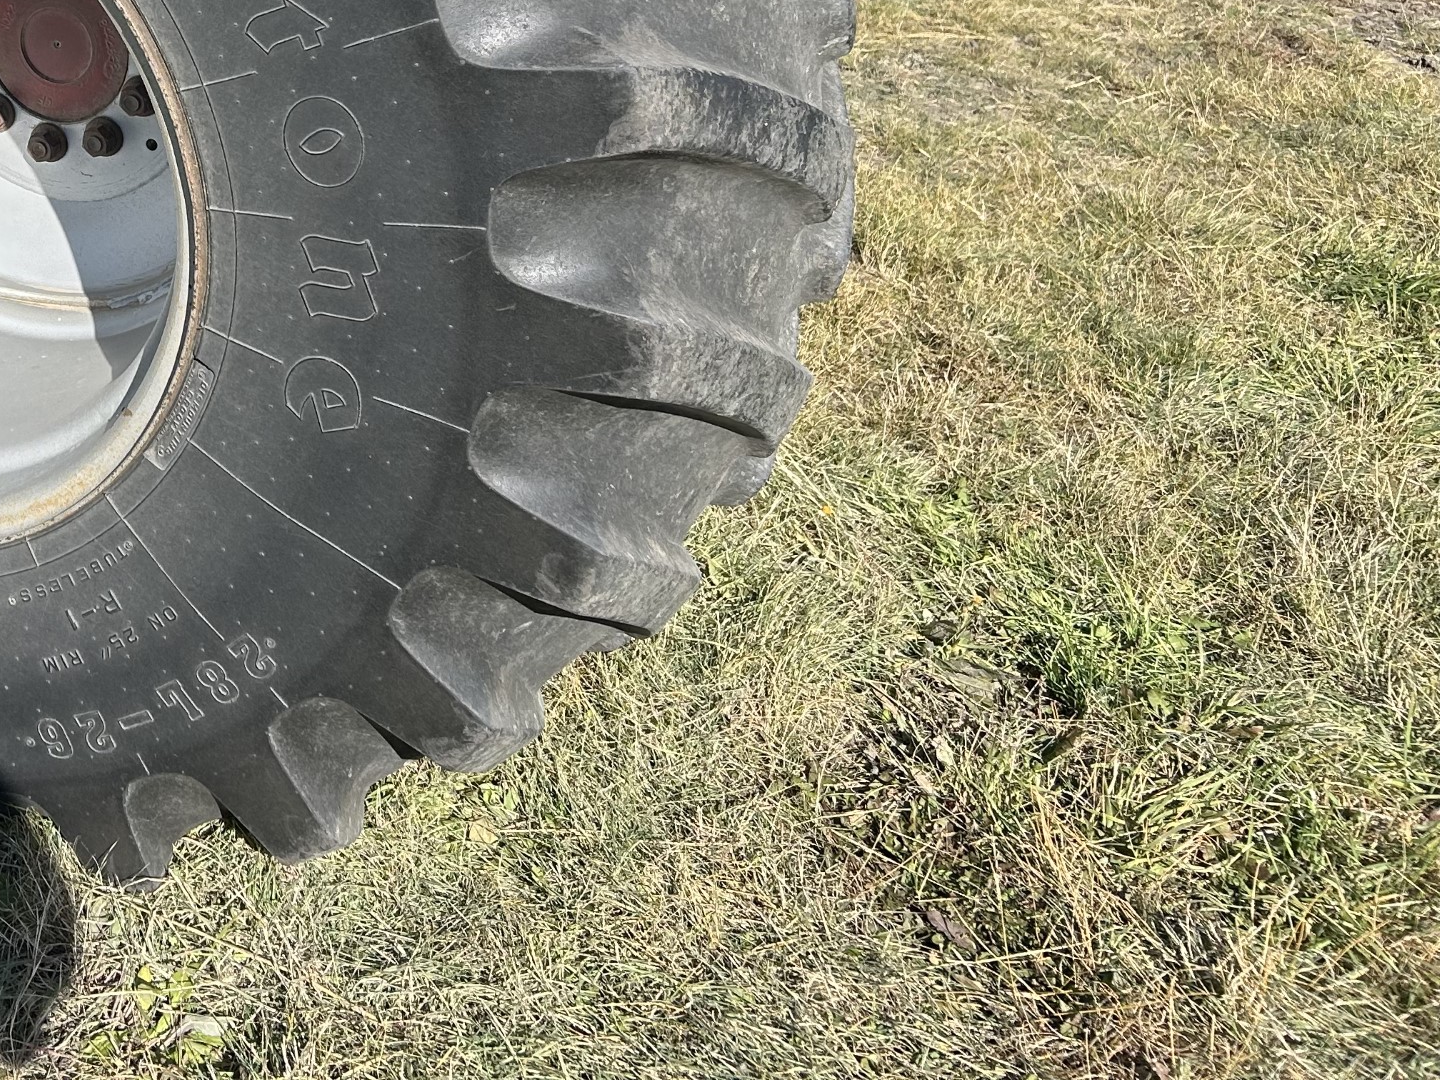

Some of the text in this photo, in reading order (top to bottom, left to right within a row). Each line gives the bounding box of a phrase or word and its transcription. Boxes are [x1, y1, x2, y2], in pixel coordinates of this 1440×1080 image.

[19, 546, 132, 603] TUBELESS
[64, 588, 124, 632] R-1
[147, 606, 179, 632] ON
[41, 648, 85, 674] RIM
[36, 632, 277, 760] 28L-26
